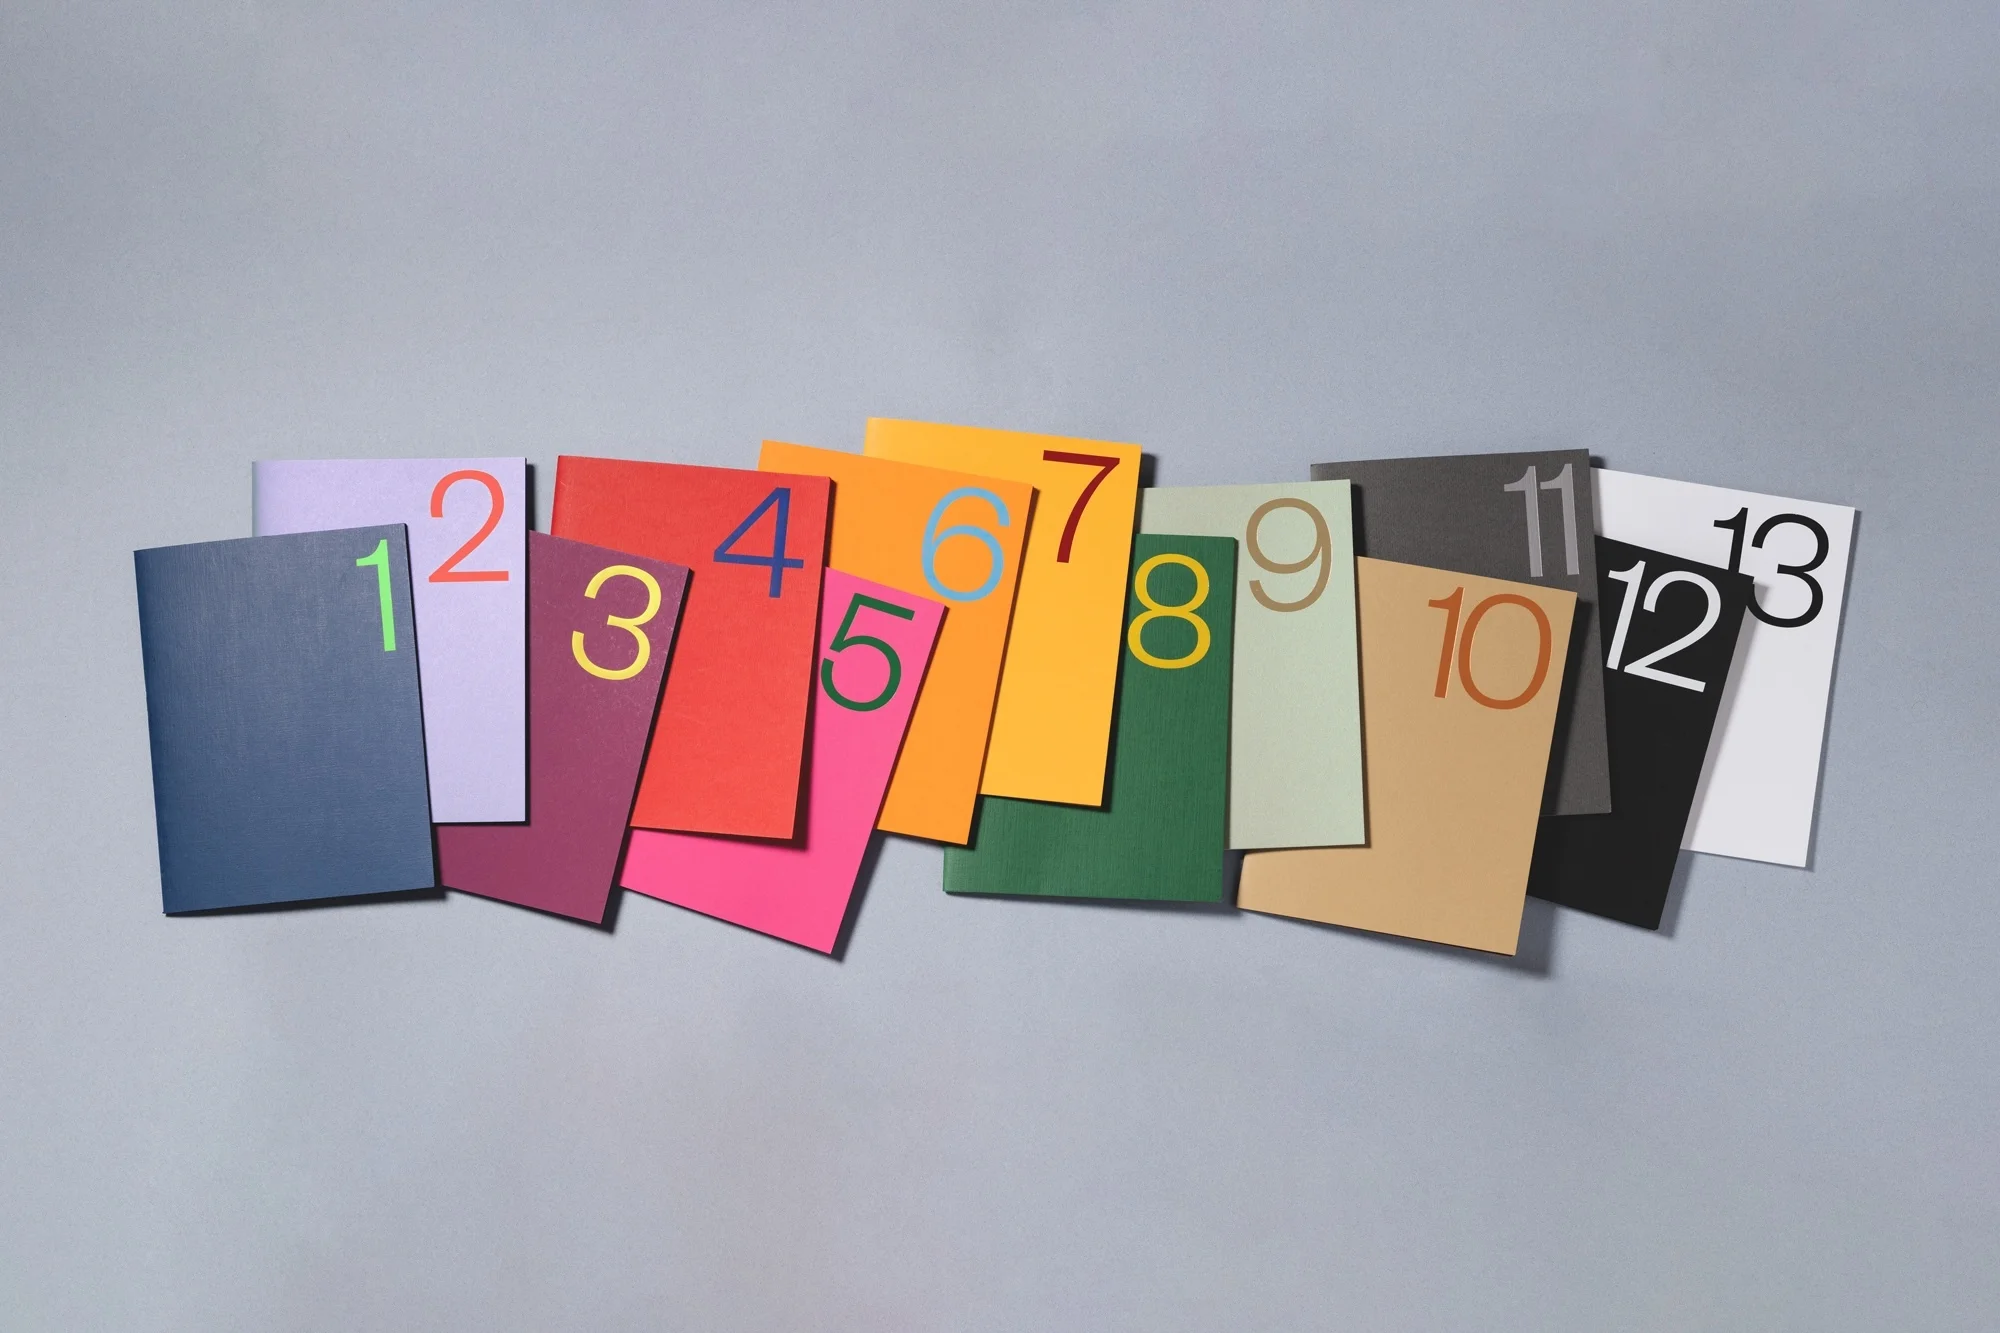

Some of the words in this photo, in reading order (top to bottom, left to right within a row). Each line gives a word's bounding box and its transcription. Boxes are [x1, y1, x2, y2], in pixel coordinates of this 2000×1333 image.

[428, 470, 509, 582] 2
[713, 487, 804, 598] 4
[921, 486, 1010, 603] 6
[1043, 449, 1120, 563] 7
[1245, 498, 1332, 612] 9
[1503, 463, 1579, 577] 11
[356, 539, 396, 652] 1
[571, 565, 662, 680] 3
[1127, 553, 1211, 669] 8
[1713, 507, 1830, 628] 13
[820, 592, 915, 712] 5
[1428, 586, 1552, 710] 10
[1606, 560, 1721, 692] 12
